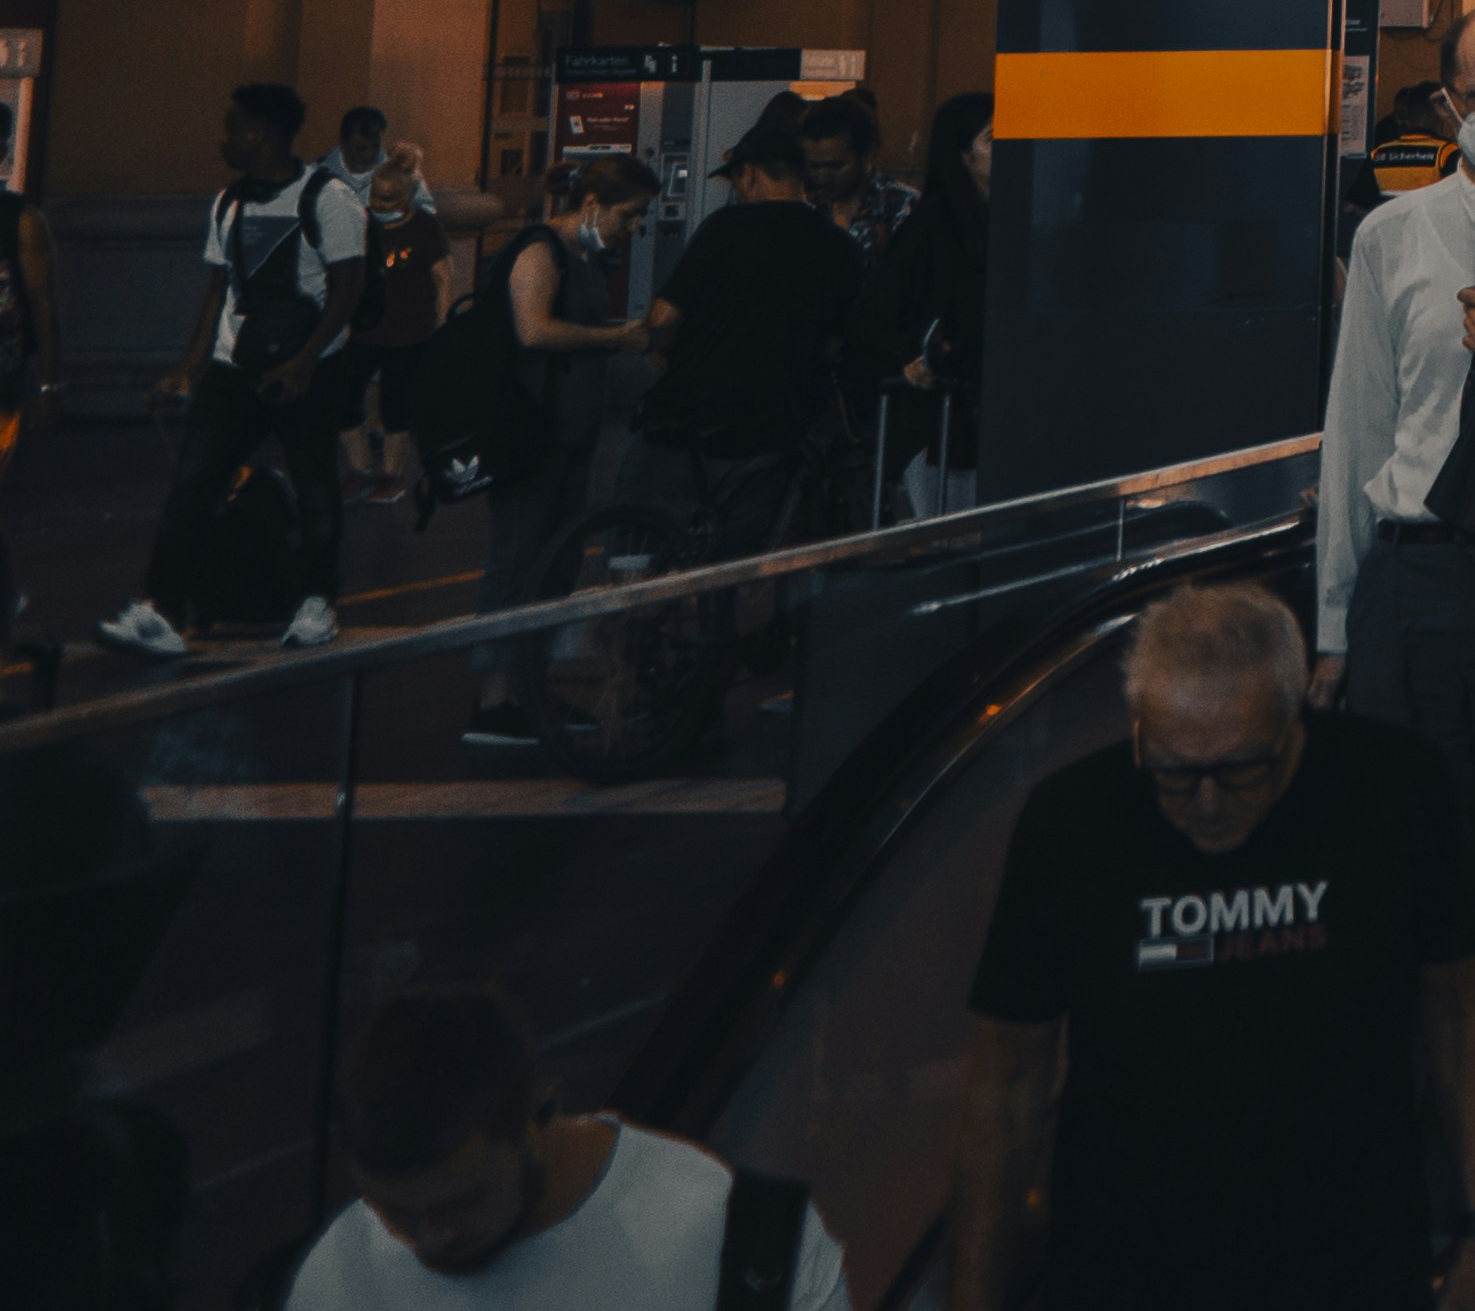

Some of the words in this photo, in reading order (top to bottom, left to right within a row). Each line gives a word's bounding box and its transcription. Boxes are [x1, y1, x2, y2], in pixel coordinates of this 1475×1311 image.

[566, 54, 628, 67] Fahrkarten
[1140, 879, 1331, 941] TOMMY
[1219, 924, 1329, 965] JEANS
